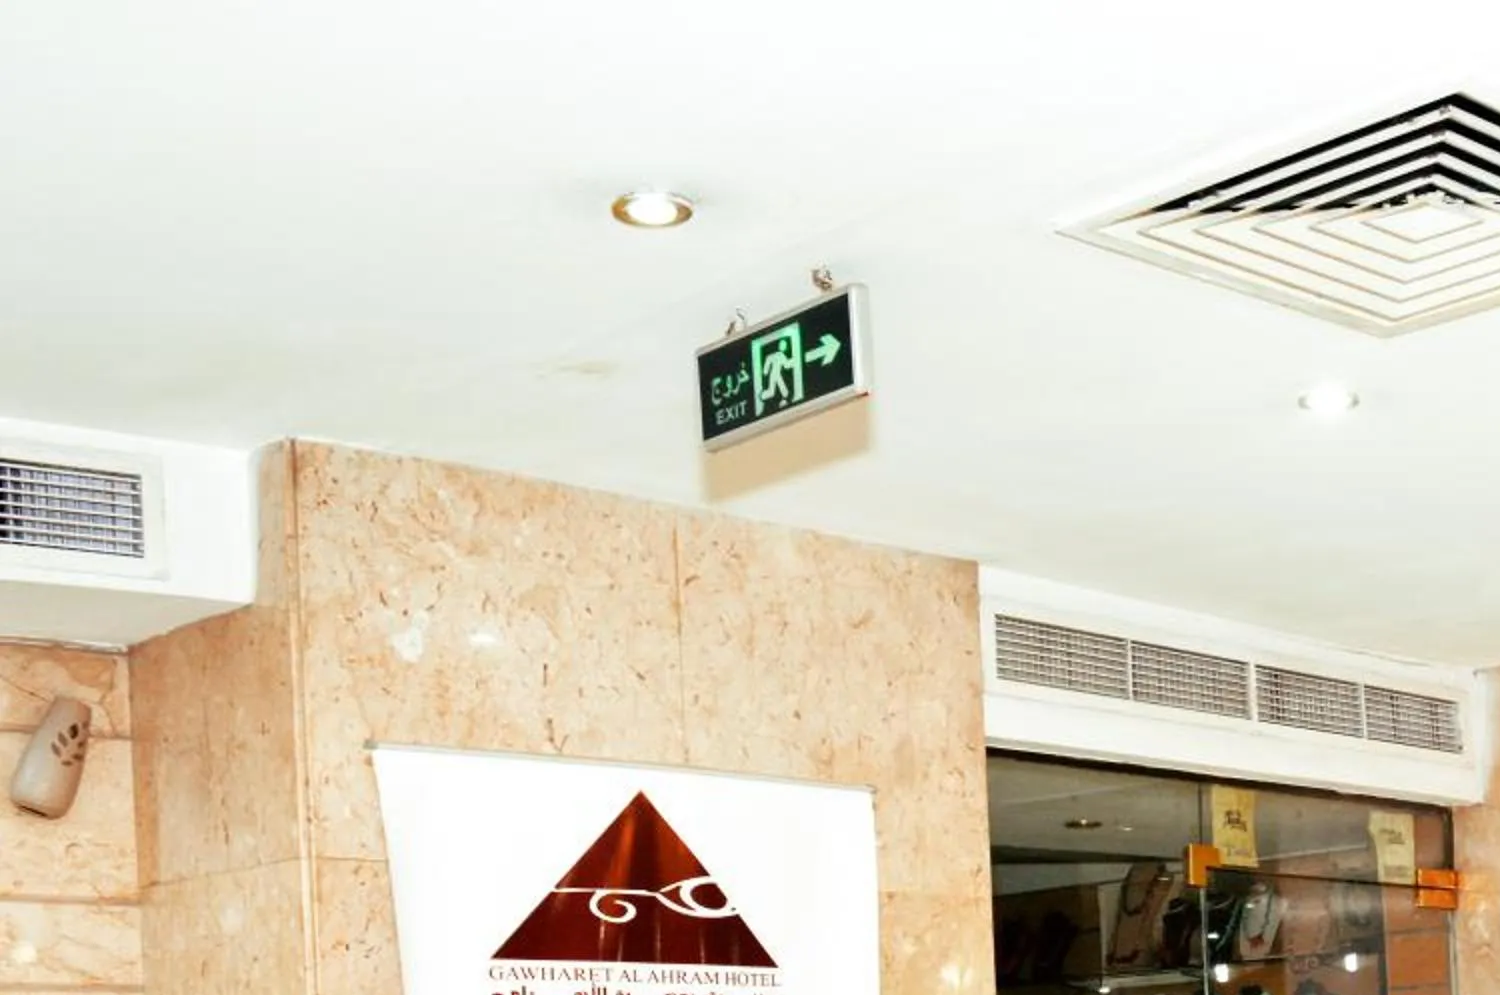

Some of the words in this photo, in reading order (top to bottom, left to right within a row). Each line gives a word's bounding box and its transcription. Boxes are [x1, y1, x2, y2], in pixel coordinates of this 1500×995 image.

[711, 361, 750, 406] خروج
[716, 402, 747, 425] EXIT
[489, 966, 614, 983] GAWHARET
[619, 969, 643, 983] AL
[647, 970, 719, 985] AHRAM
[725, 972, 782, 987] HOTEL
